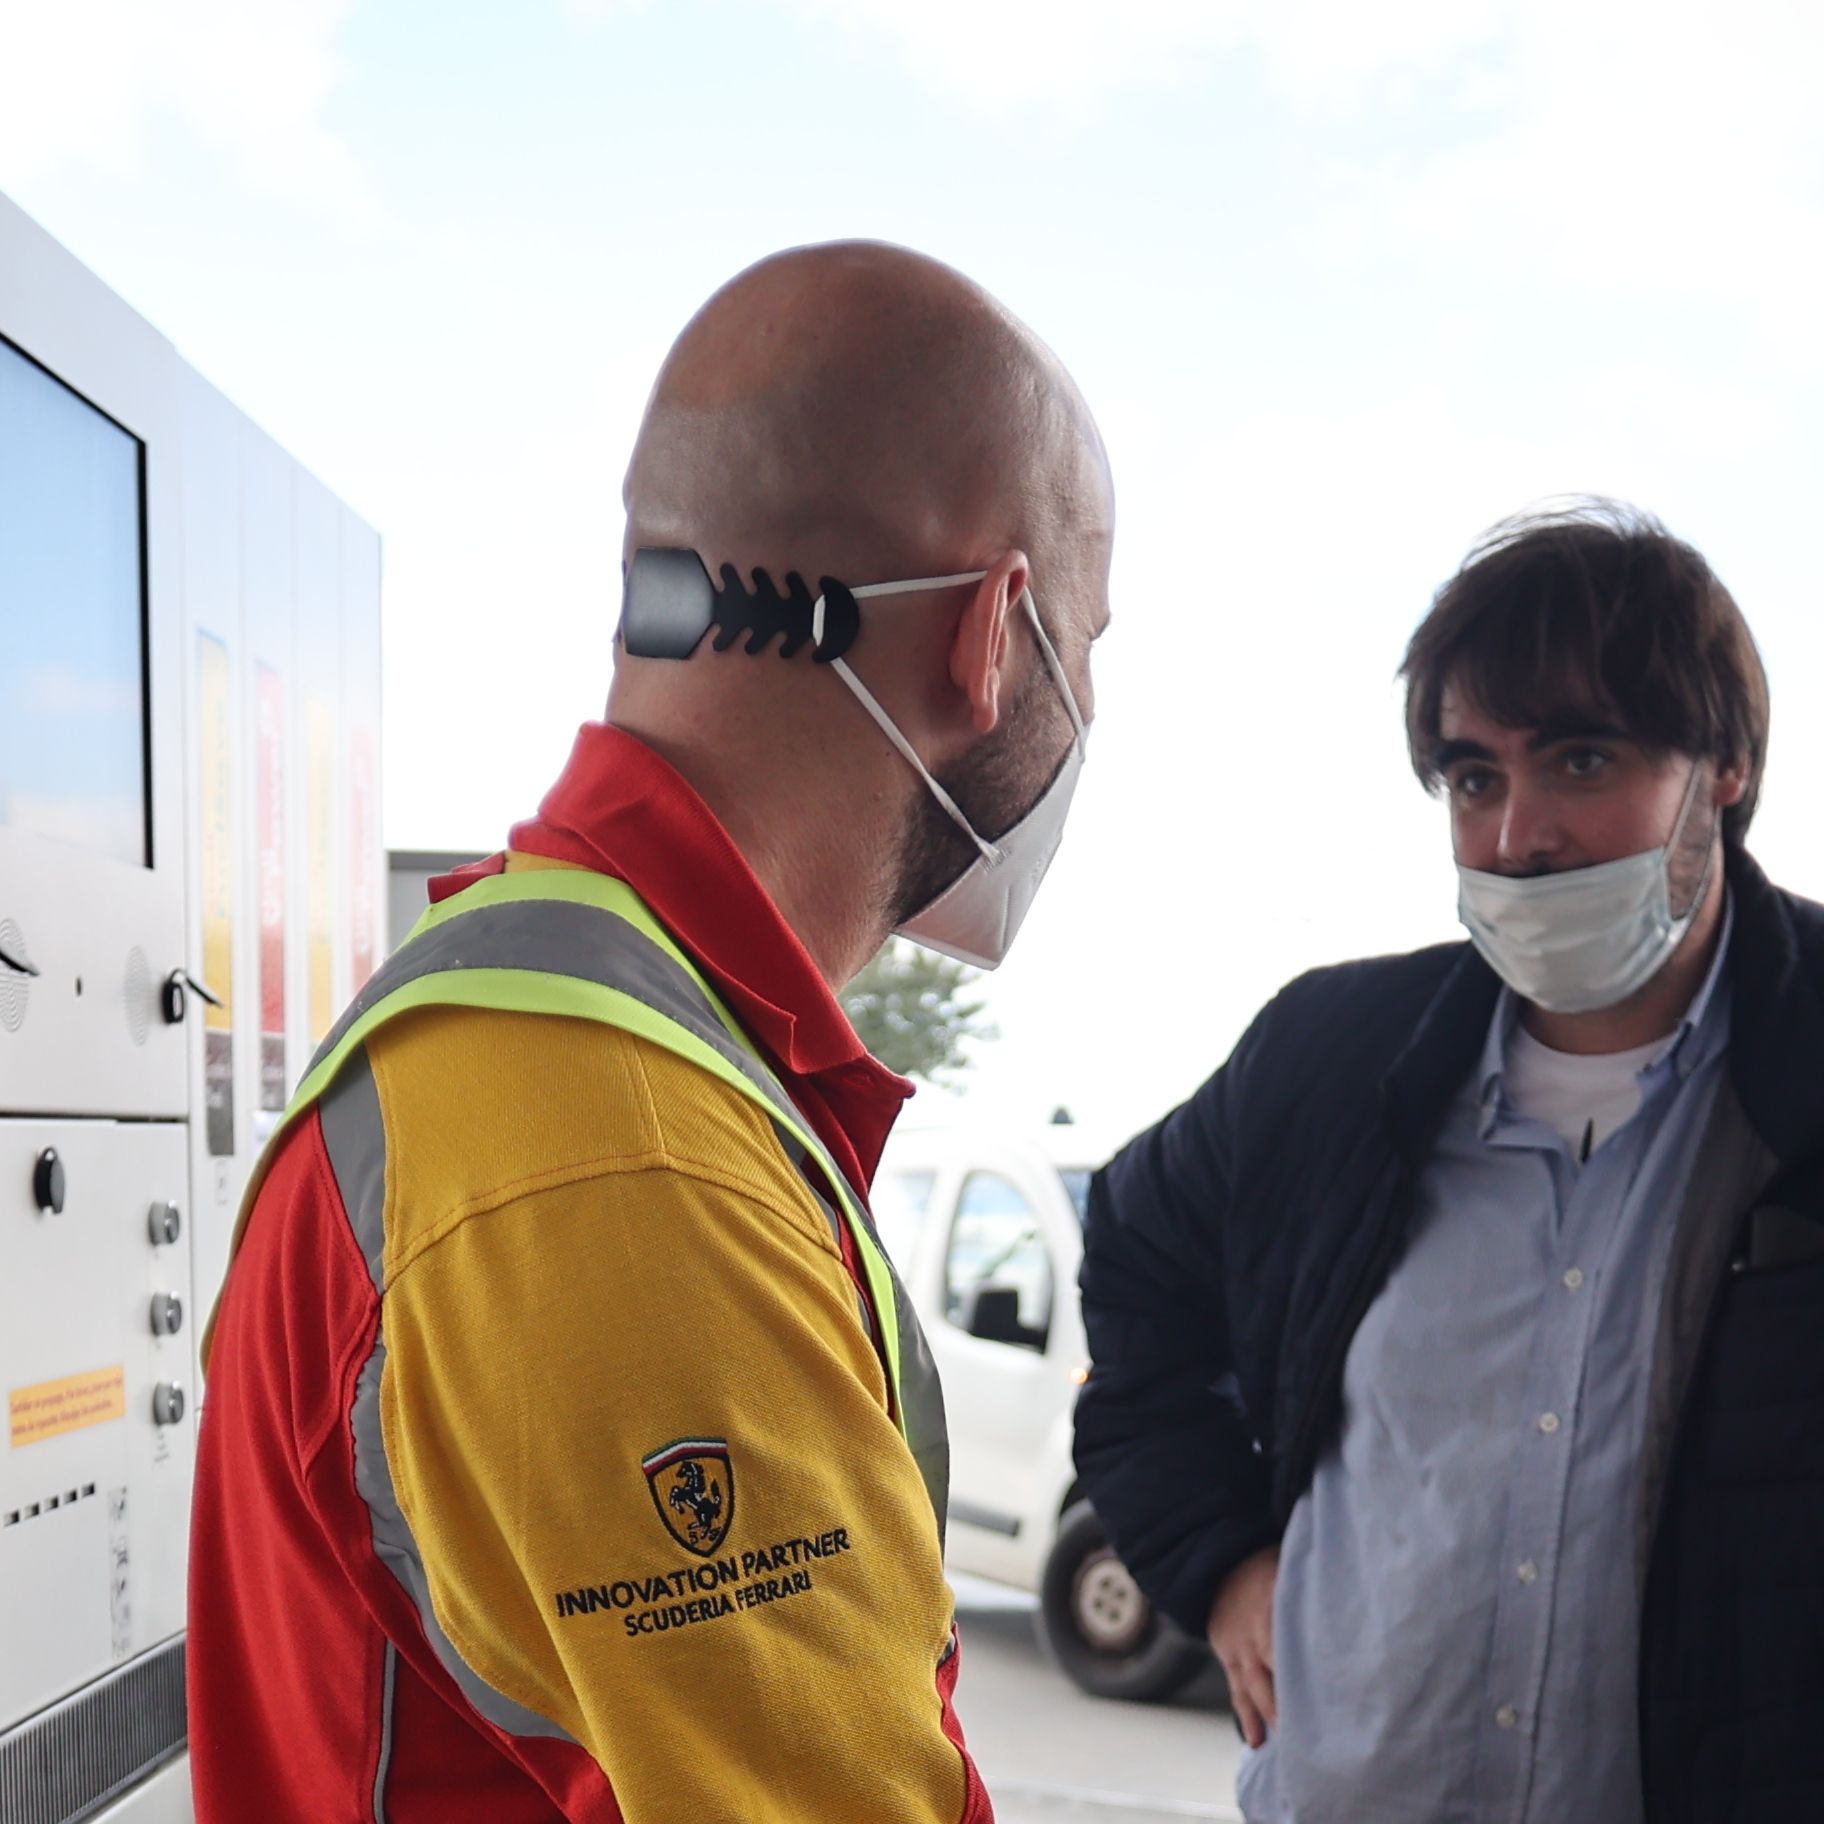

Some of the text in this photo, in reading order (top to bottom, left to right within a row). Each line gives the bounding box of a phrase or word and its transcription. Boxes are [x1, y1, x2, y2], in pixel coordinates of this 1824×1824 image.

[555, 1528, 851, 1617] INNOVATION PARTNER
[624, 1570, 812, 1637] SCUDERIA FERRARI
